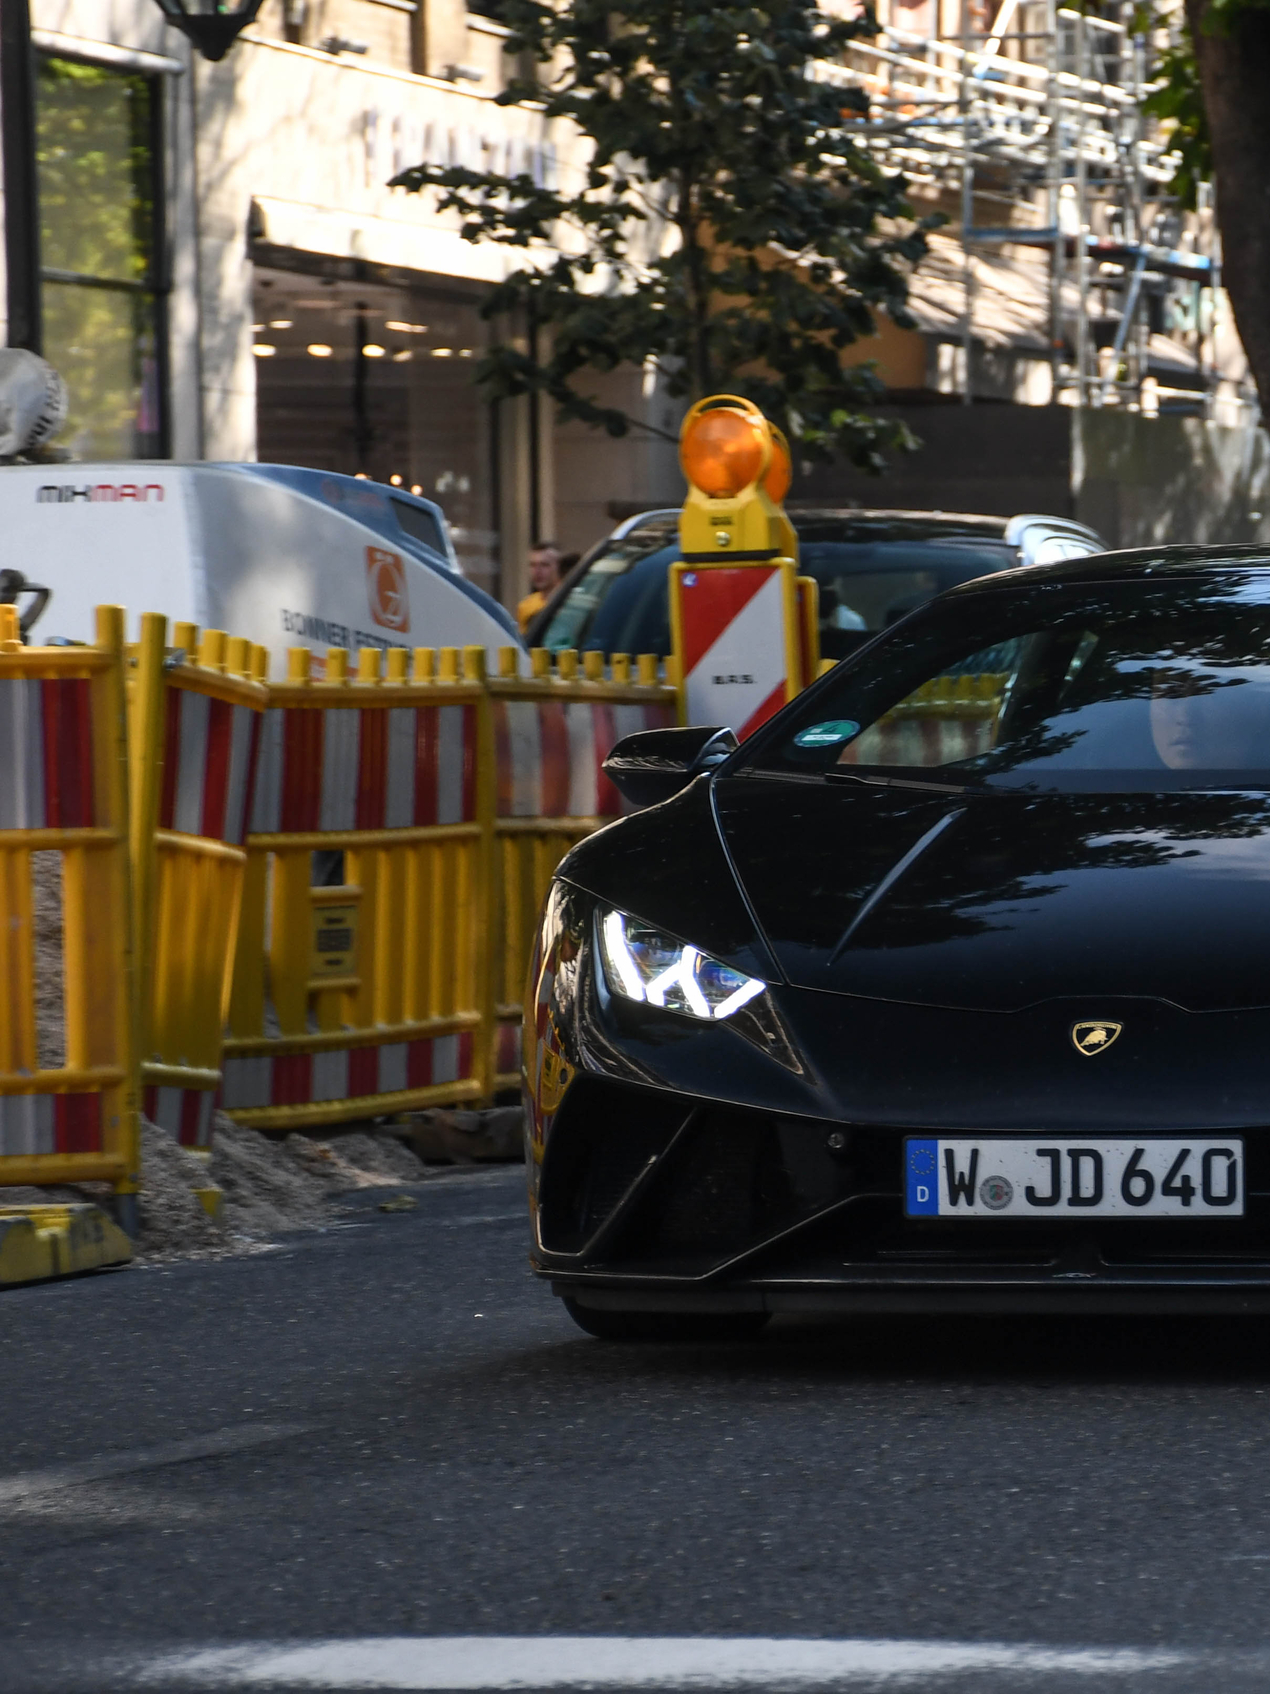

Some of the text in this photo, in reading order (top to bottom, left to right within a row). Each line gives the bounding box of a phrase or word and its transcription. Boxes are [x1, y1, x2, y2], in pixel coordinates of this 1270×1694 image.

[916, 1185, 929, 1202] D
[943, 1148, 980, 1207] W
[1025, 1148, 1104, 1207] JD
[1120, 1148, 1237, 1207] 640
